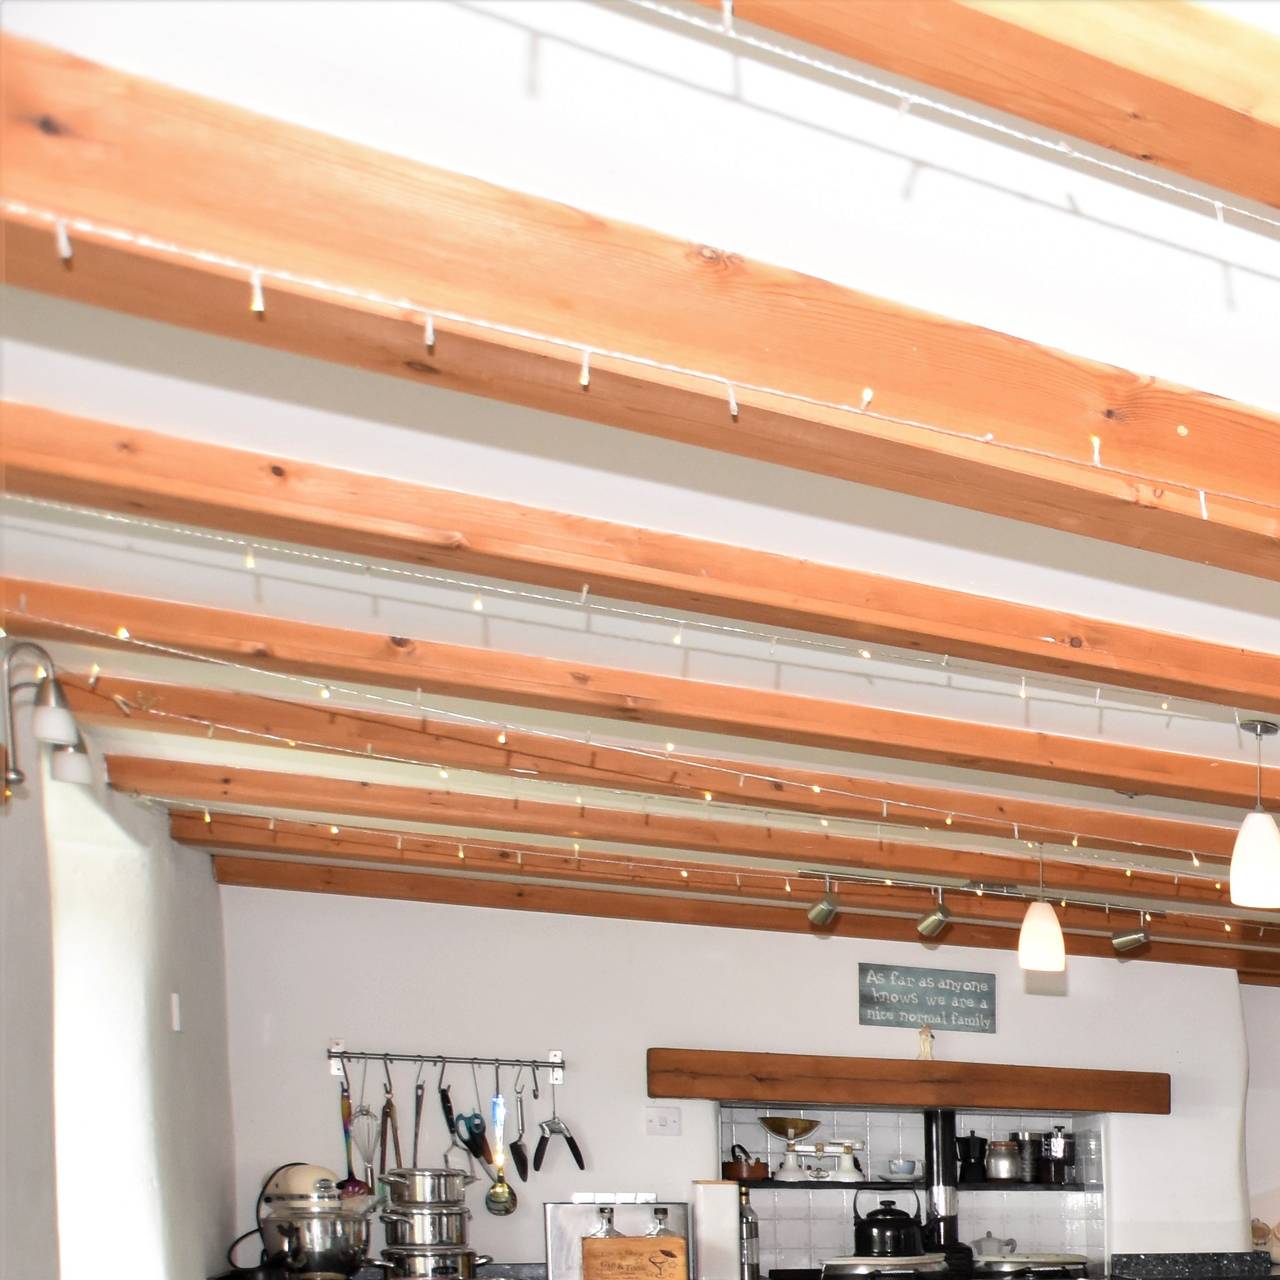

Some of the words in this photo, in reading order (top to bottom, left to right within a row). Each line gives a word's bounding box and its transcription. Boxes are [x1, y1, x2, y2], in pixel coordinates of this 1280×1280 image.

[866, 969, 885, 984] As
[891, 971, 915, 987] far
[919, 977, 934, 988] as
[938, 978, 988, 992] anyone
[871, 987, 919, 1004] knows
[926, 996, 945, 1006] we
[952, 997, 974, 1008] are
[980, 999, 989, 1009] a
[867, 1006, 894, 1020] nice
[899, 1011, 948, 1025] normal
[951, 1011, 991, 1029] family
